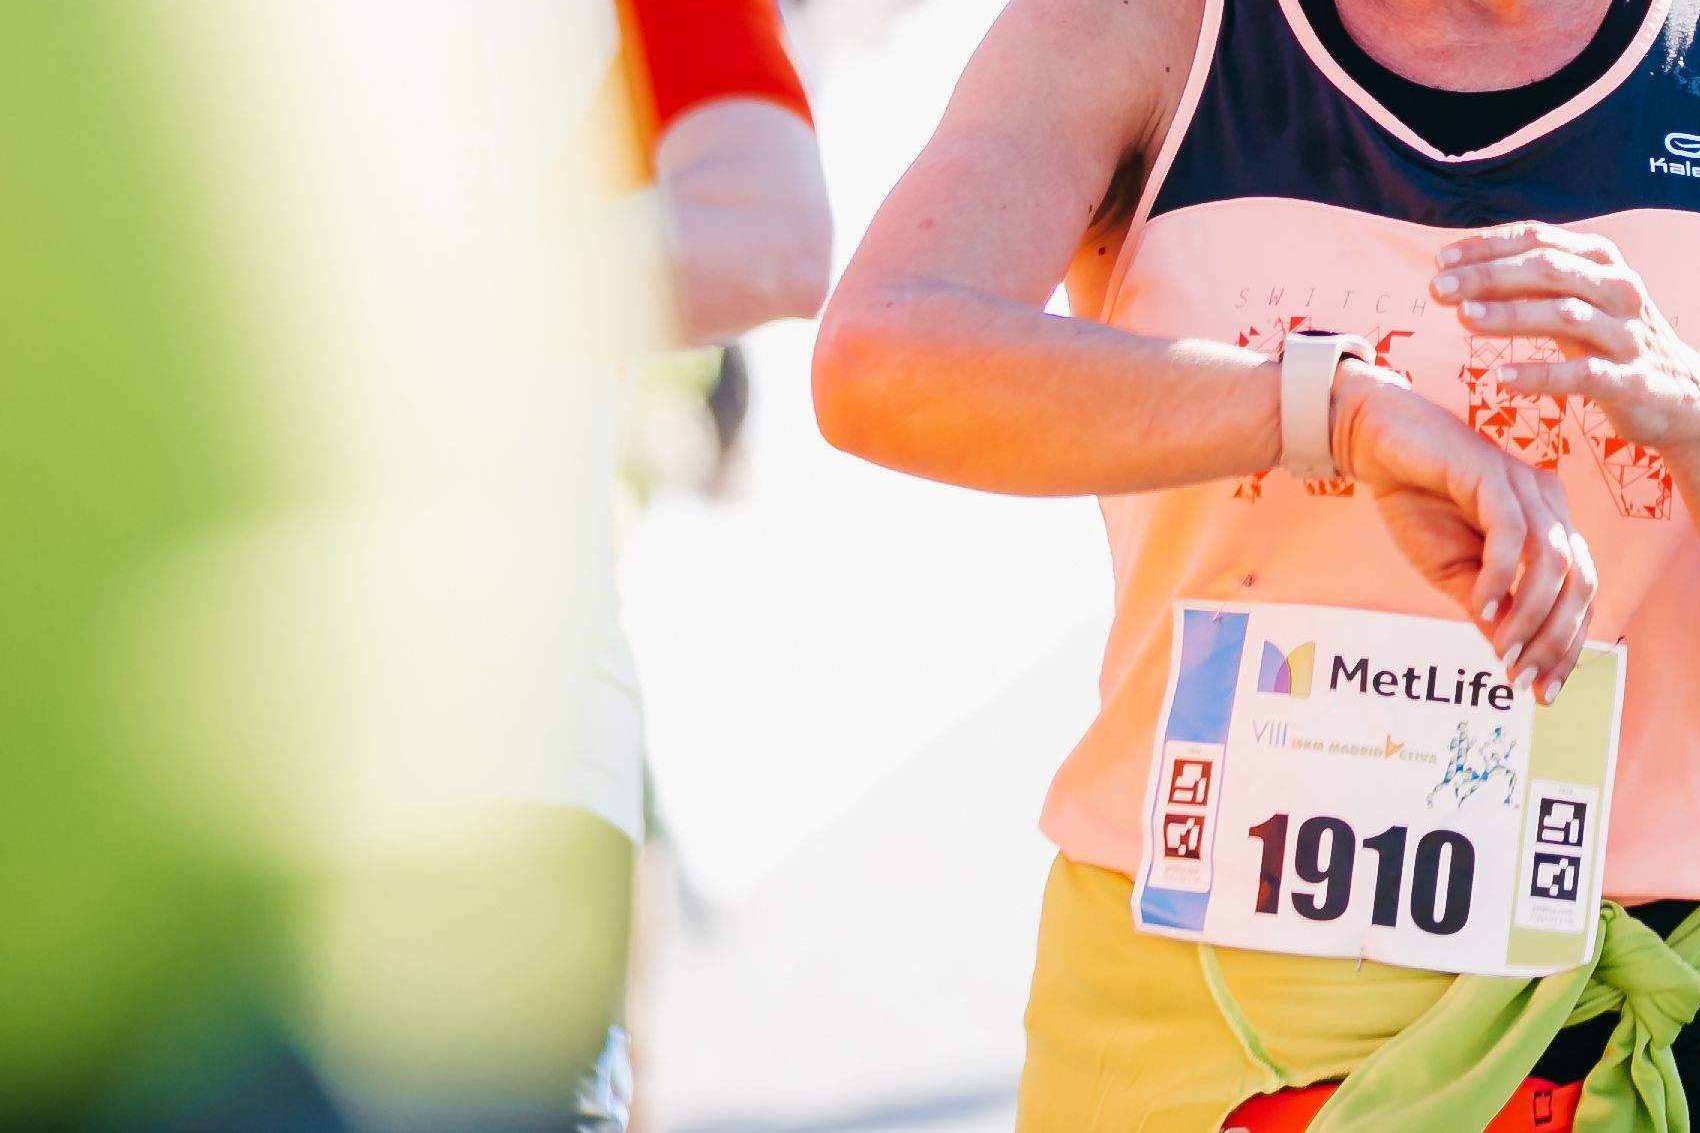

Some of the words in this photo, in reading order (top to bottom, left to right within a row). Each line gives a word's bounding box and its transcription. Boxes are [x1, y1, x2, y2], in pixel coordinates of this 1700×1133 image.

[1329, 655, 1515, 711] MetLife
[1252, 721, 1288, 747] VIII
[1248, 812, 1476, 936] 1910
